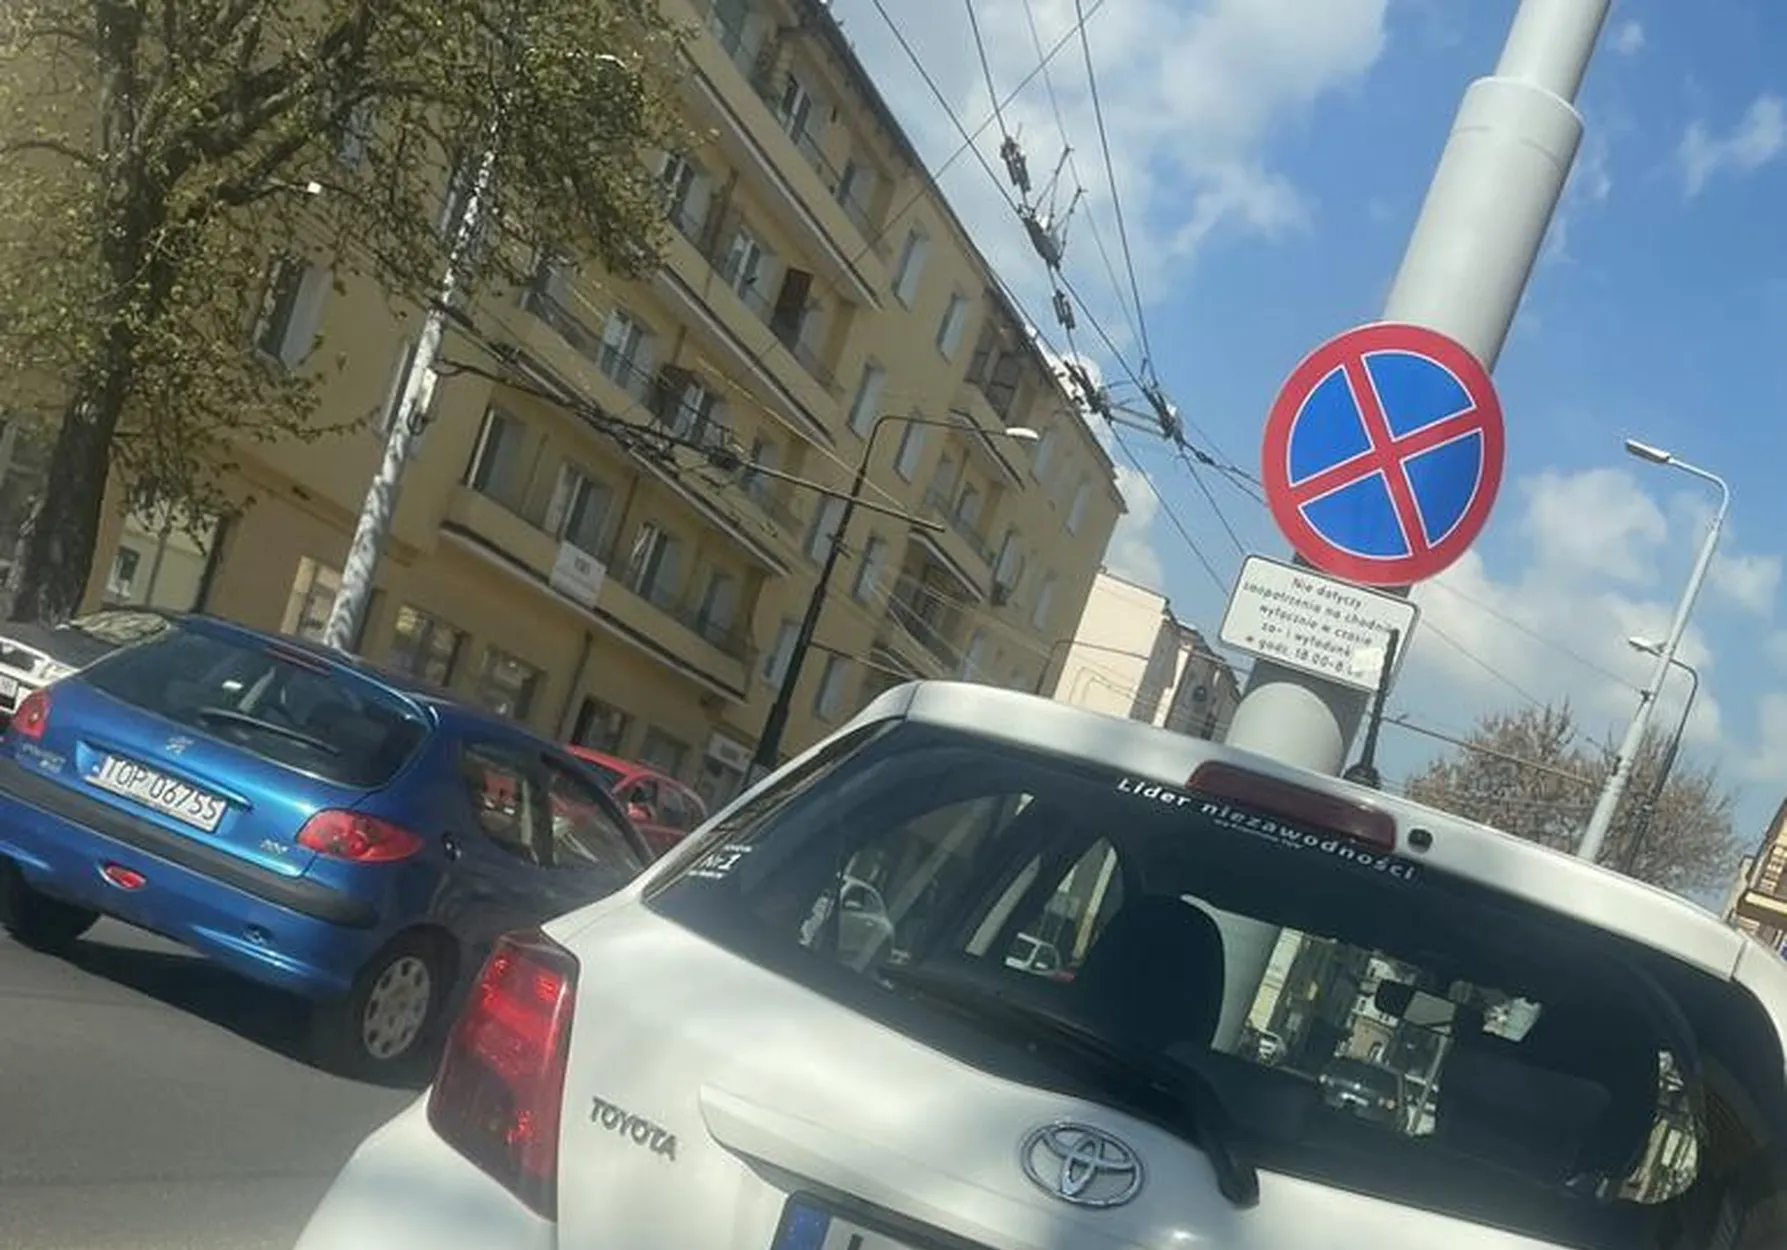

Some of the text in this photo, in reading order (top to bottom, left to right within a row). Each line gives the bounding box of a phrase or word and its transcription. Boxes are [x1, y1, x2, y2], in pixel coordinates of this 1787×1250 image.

[106, 755, 147, 794] TOP
[149, 772, 219, 821] 06755
[1116, 777, 1192, 808] Lider
[1199, 801, 1416, 881] niezawodności
[590, 1095, 677, 1162] TOYOTA
